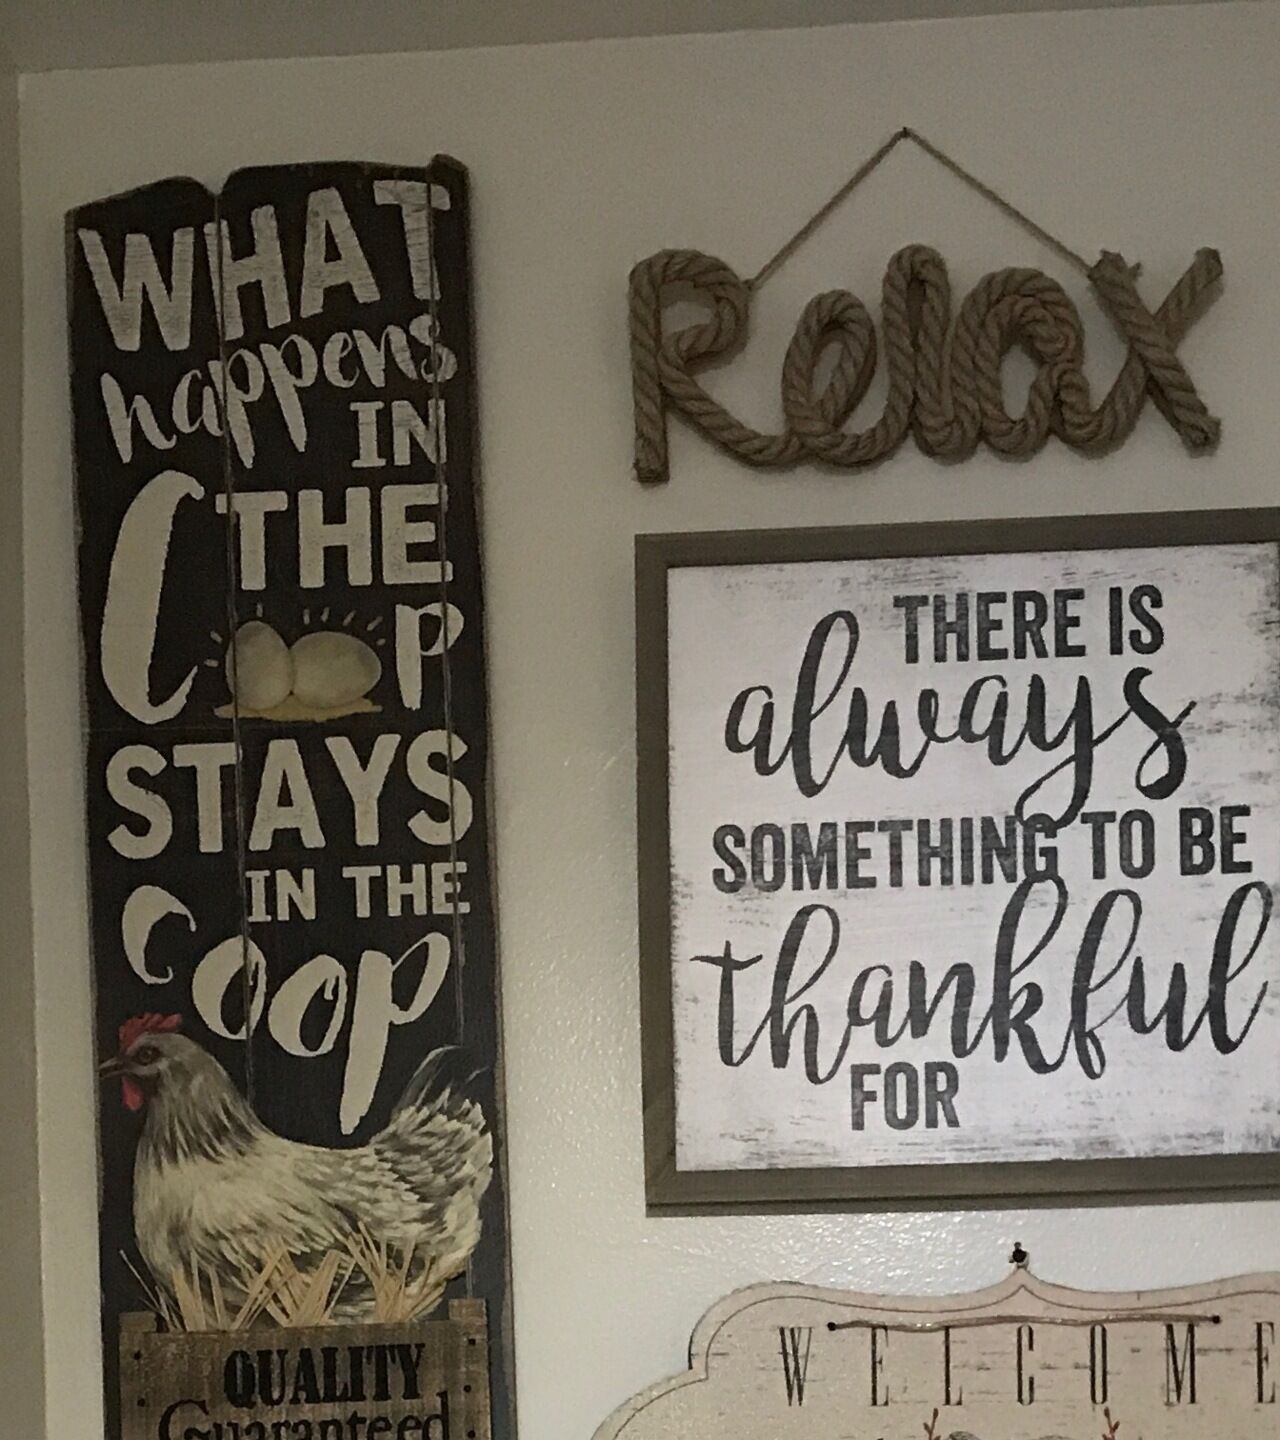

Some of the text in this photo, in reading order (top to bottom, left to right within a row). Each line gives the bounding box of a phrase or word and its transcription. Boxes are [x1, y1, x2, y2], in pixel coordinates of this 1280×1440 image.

[78, 179, 451, 352] WHAT
[100, 313, 458, 469] happens
[350, 399, 448, 468] IN
[215, 483, 453, 591] THE
[893, 584, 1165, 663] THERE IS
[724, 609, 1198, 832] always
[106, 729, 473, 860] STAYS
[244, 861, 471, 922] IN THE
[712, 805, 1253, 894] SOMETHING TO BE
[689, 873, 1273, 1085] thankful
[850, 1061, 960, 1131] FOR
[223, 1343, 426, 1409] QUALITY
[777, 1321, 1277, 1407] WELCOME
